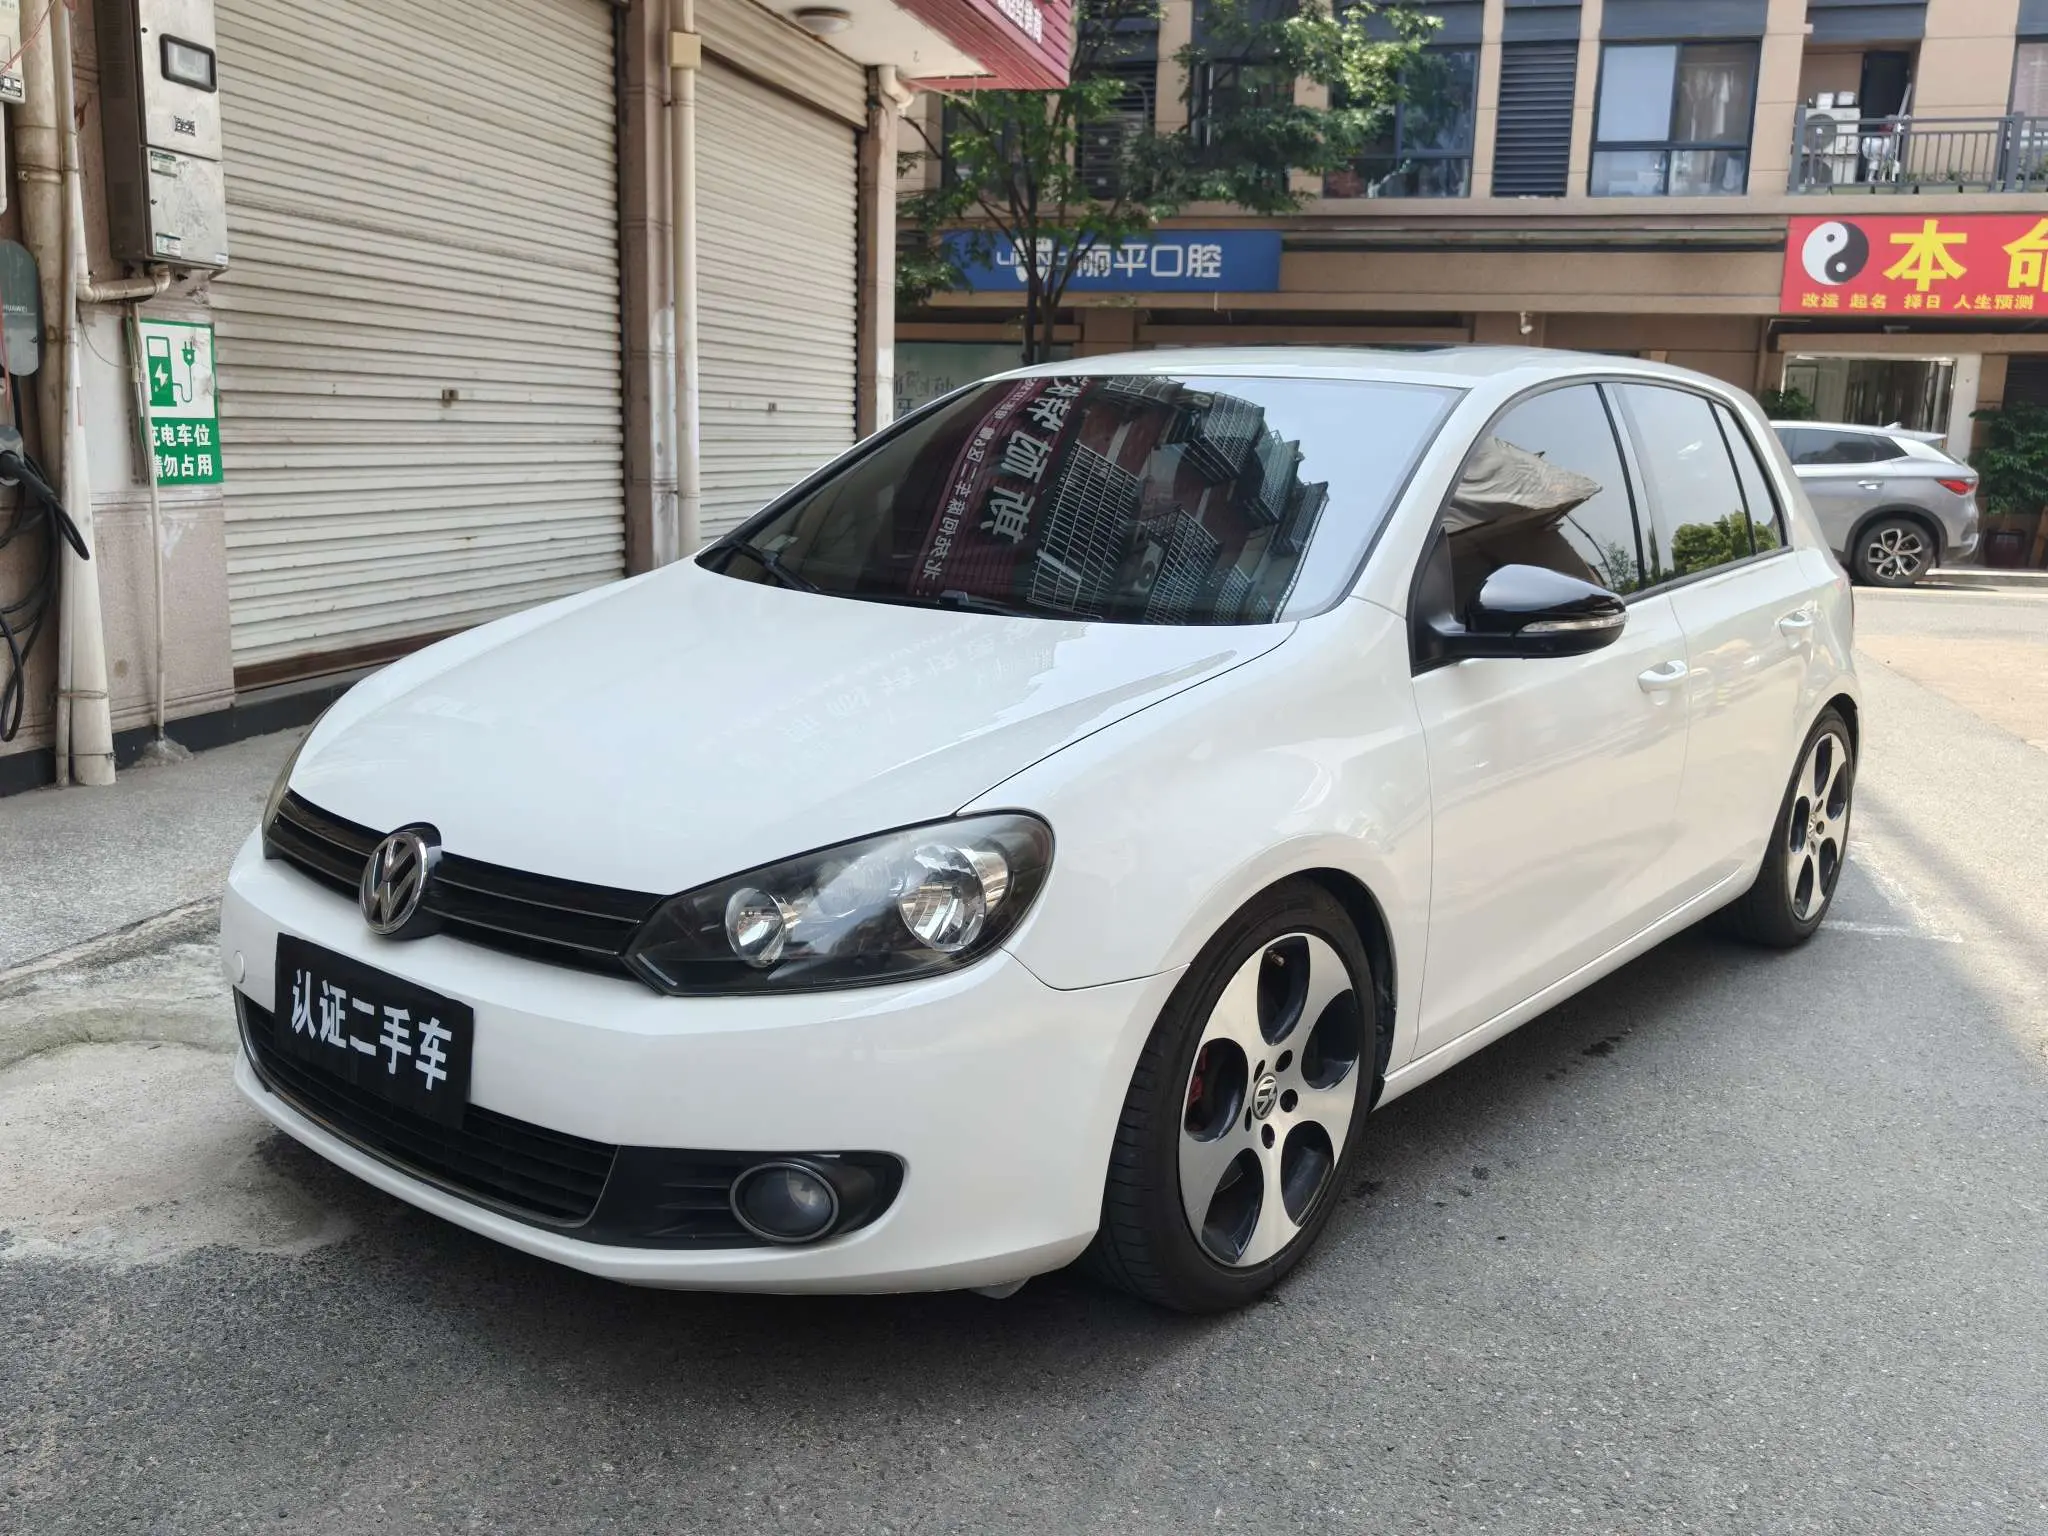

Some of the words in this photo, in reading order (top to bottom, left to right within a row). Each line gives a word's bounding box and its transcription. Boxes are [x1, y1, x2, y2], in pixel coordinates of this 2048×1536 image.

[1076, 243, 1222, 278] 丽平口腔
[291, 968, 453, 1092] 认证二手车
